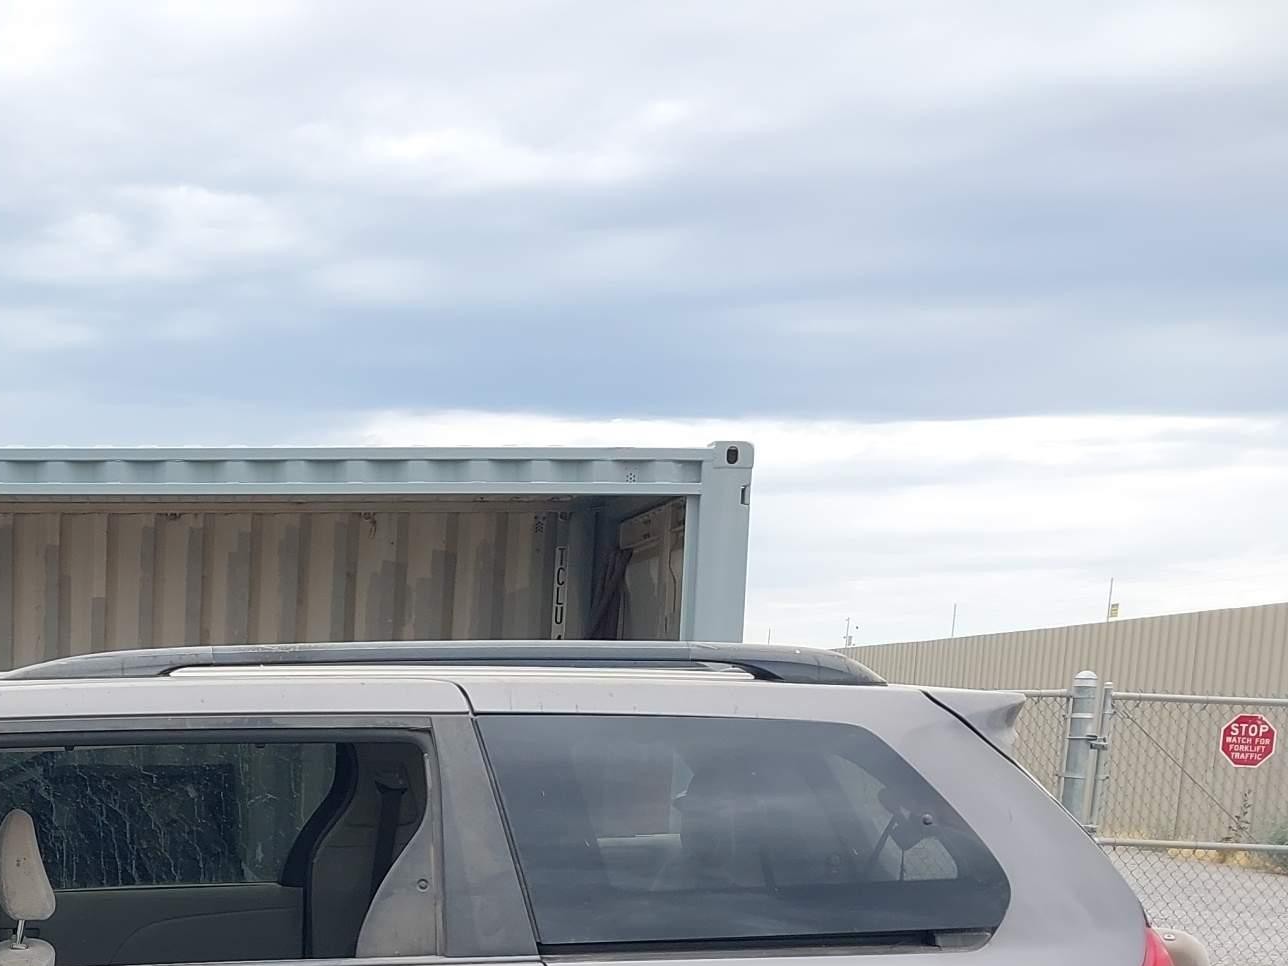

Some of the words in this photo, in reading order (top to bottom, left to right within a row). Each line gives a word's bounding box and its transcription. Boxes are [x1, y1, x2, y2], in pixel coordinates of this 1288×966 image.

[555, 547, 566, 624] TCLU
[1231, 724, 1269, 737] STOP
[1225, 736, 1252, 744] WATCH
[1228, 744, 1266, 753] FORKLIFT
